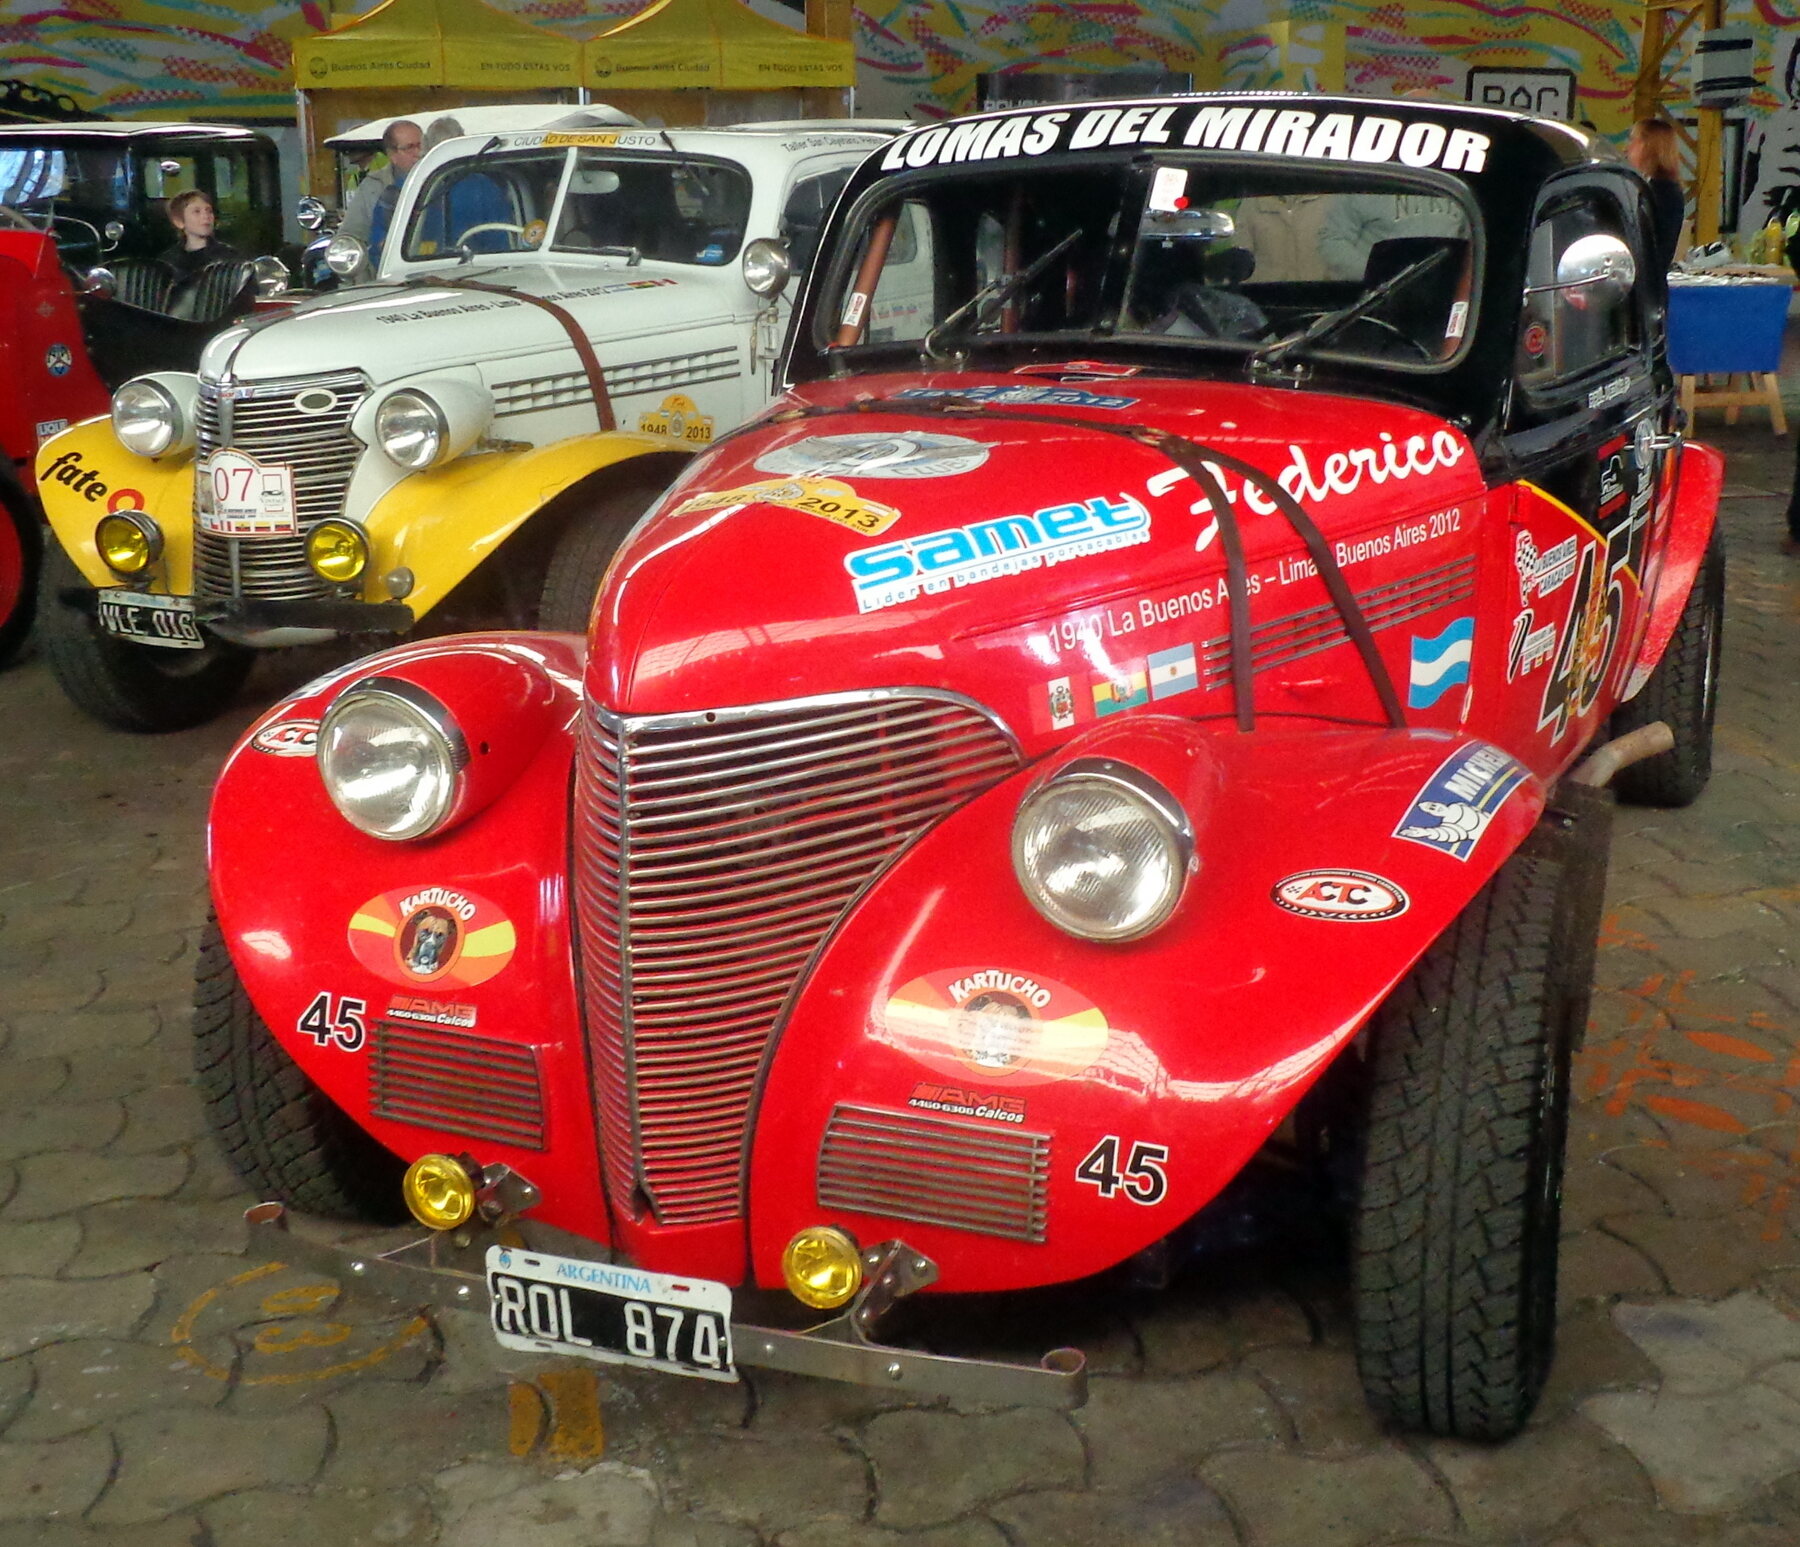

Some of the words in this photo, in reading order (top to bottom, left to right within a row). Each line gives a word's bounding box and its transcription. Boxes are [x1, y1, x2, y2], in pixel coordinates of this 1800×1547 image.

[397, 60, 431, 70] Ciudad
[552, 64, 571, 72] VOS
[514, 135, 556, 147] CIUDAD
[559, 134, 574, 144] DE
[578, 134, 608, 144] SAN
[609, 135, 656, 146] JUSTO
[880, 112, 1070, 171] LOMAS
[1069, 106, 1180, 150] DEL
[1183, 106, 1491, 174] MIRADOR
[686, 426, 711, 439] 2013
[41, 452, 108, 502] fate
[214, 467, 254, 502] 07
[1146, 429, 1465, 552] Federico
[798, 497, 880, 529] 2013
[850, 499, 1144, 591] samet
[927, 578, 948, 592] en
[957, 554, 1040, 583] bandejas
[1047, 529, 1149, 563] portacables
[1108, 608, 1136, 636] La
[1138, 585, 1214, 627] Buenos
[1215, 577, 1261, 607] Aes
[1279, 556, 1319, 586] Lima
[1336, 534, 1392, 568] Buenos
[1393, 523, 1428, 549] Aires
[1430, 509, 1461, 536] 2012
[152, 610, 196, 640] 016
[399, 886, 477, 921] KARTUCHO
[1296, 881, 1372, 905] ACTC
[948, 969, 1052, 1008] KARTUCHO
[296, 991, 366, 1053] 45
[406, 996, 477, 1019] AMG
[437, 1013, 476, 1028] Calcos
[937, 1086, 1027, 1114] AMG
[974, 1106, 1025, 1123] Calcos
[1075, 1134, 1170, 1206] 45
[556, 1262, 653, 1295] ARGENTINA
[497, 1276, 593, 1348] ROL
[623, 1300, 722, 1370] 874
